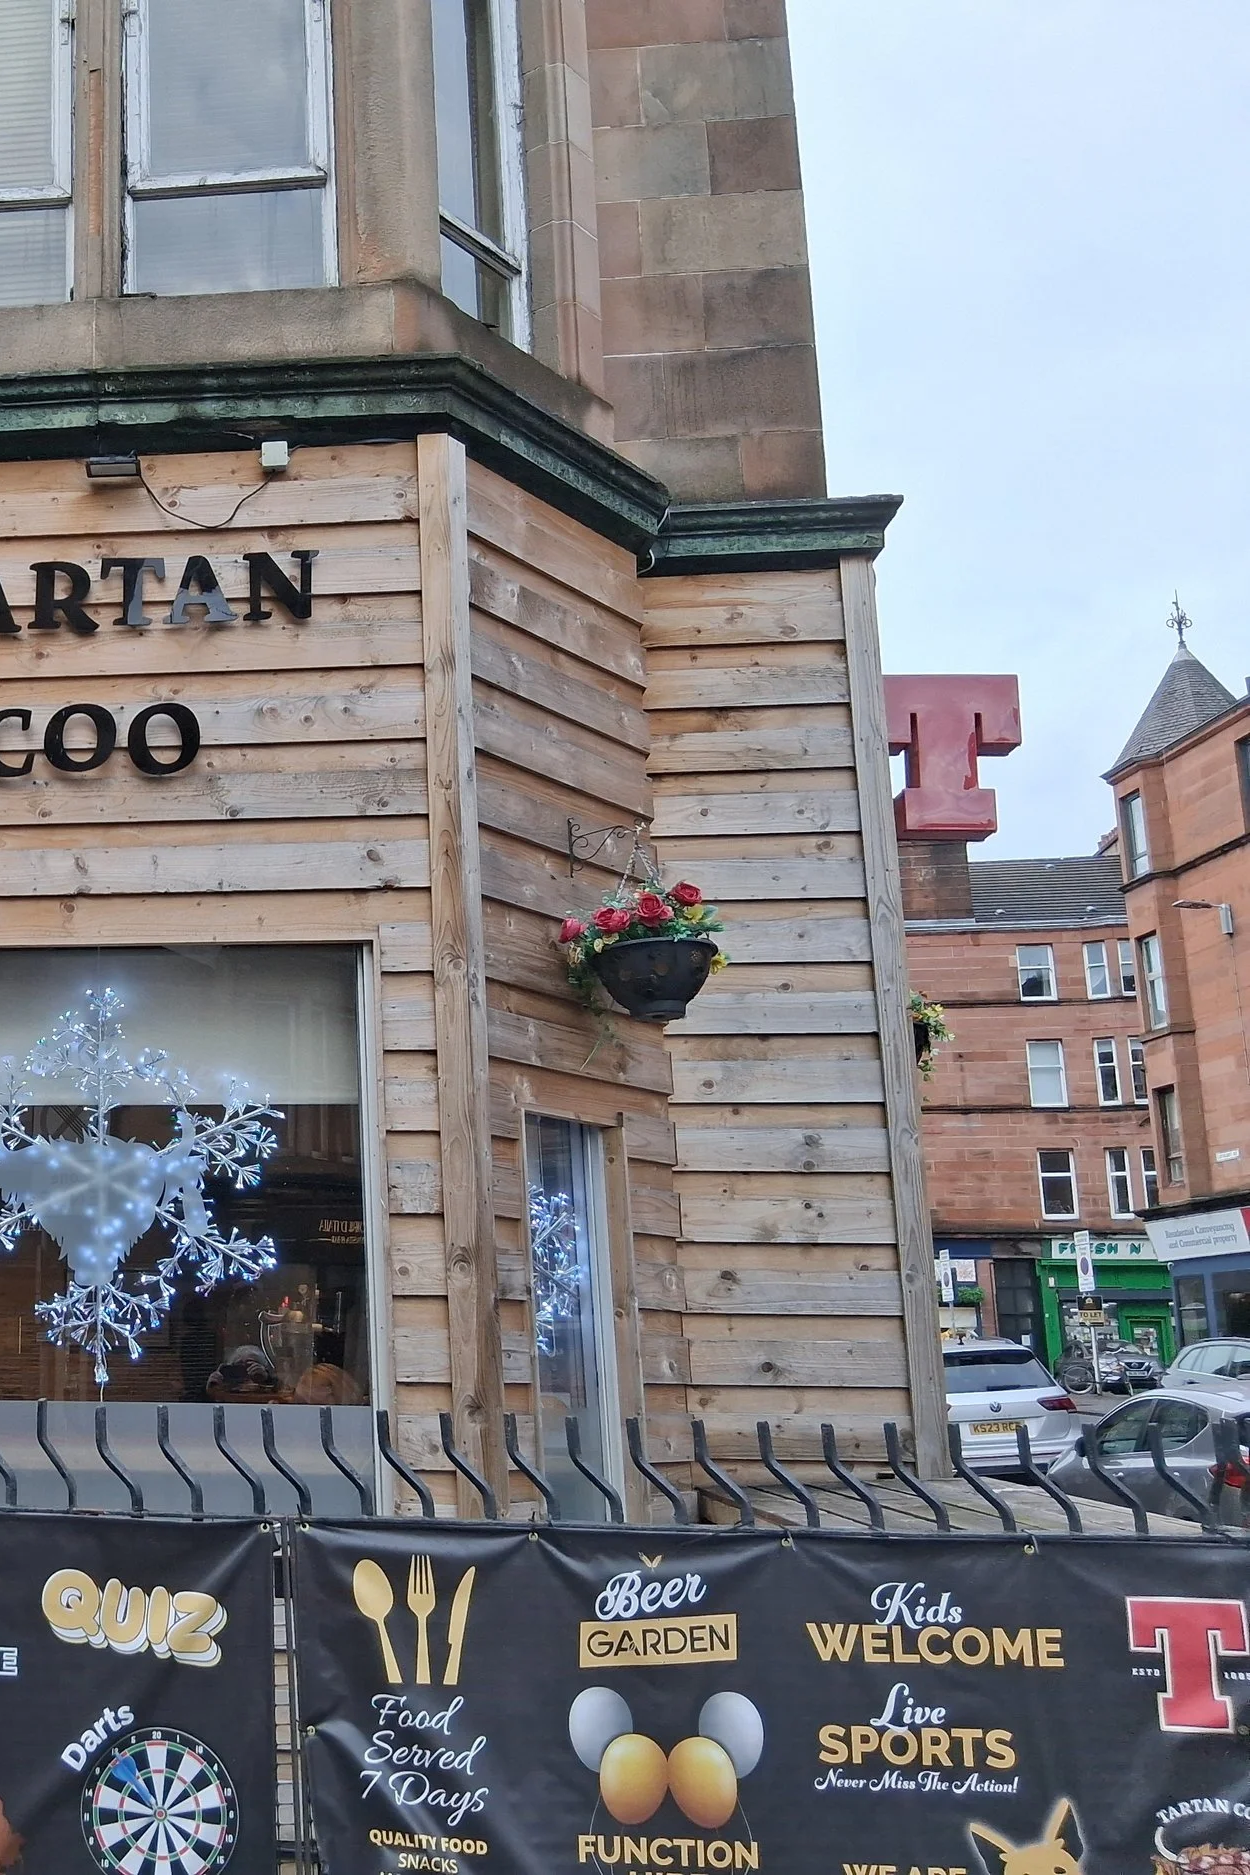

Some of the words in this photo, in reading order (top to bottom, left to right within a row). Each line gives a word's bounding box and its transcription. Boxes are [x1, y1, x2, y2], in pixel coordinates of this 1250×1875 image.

[973, 1422, 1000, 1433] KS23
[595, 1570, 707, 1621] Beer
[870, 1581, 963, 1630] Kids
[41, 1568, 229, 1668] QUIZ
[586, 1623, 731, 1660] GARDEN
[806, 1622, 1065, 1668] WELCOME
[371, 1693, 464, 1736] Food
[869, 1682, 946, 1732] Live
[60, 1702, 136, 1773] Darts
[151, 1730, 162, 1740] 20
[364, 1730, 487, 1776] Served
[818, 1724, 1017, 1769] SPORTS
[359, 1771, 383, 1801] 7
[388, 1771, 490, 1827] Days
[814, 1768, 868, 1791] Never
[868, 1769, 916, 1792] Miss
[917, 1770, 950, 1792] The
[951, 1772, 1020, 1794] Action!
[1155, 1797, 1230, 1824] TARTAN
[369, 1828, 437, 1850] QUALITY
[440, 1836, 488, 1856] FOOD
[397, 1852, 459, 1874] SNACKS
[577, 1834, 759, 1870] FUNCTION
